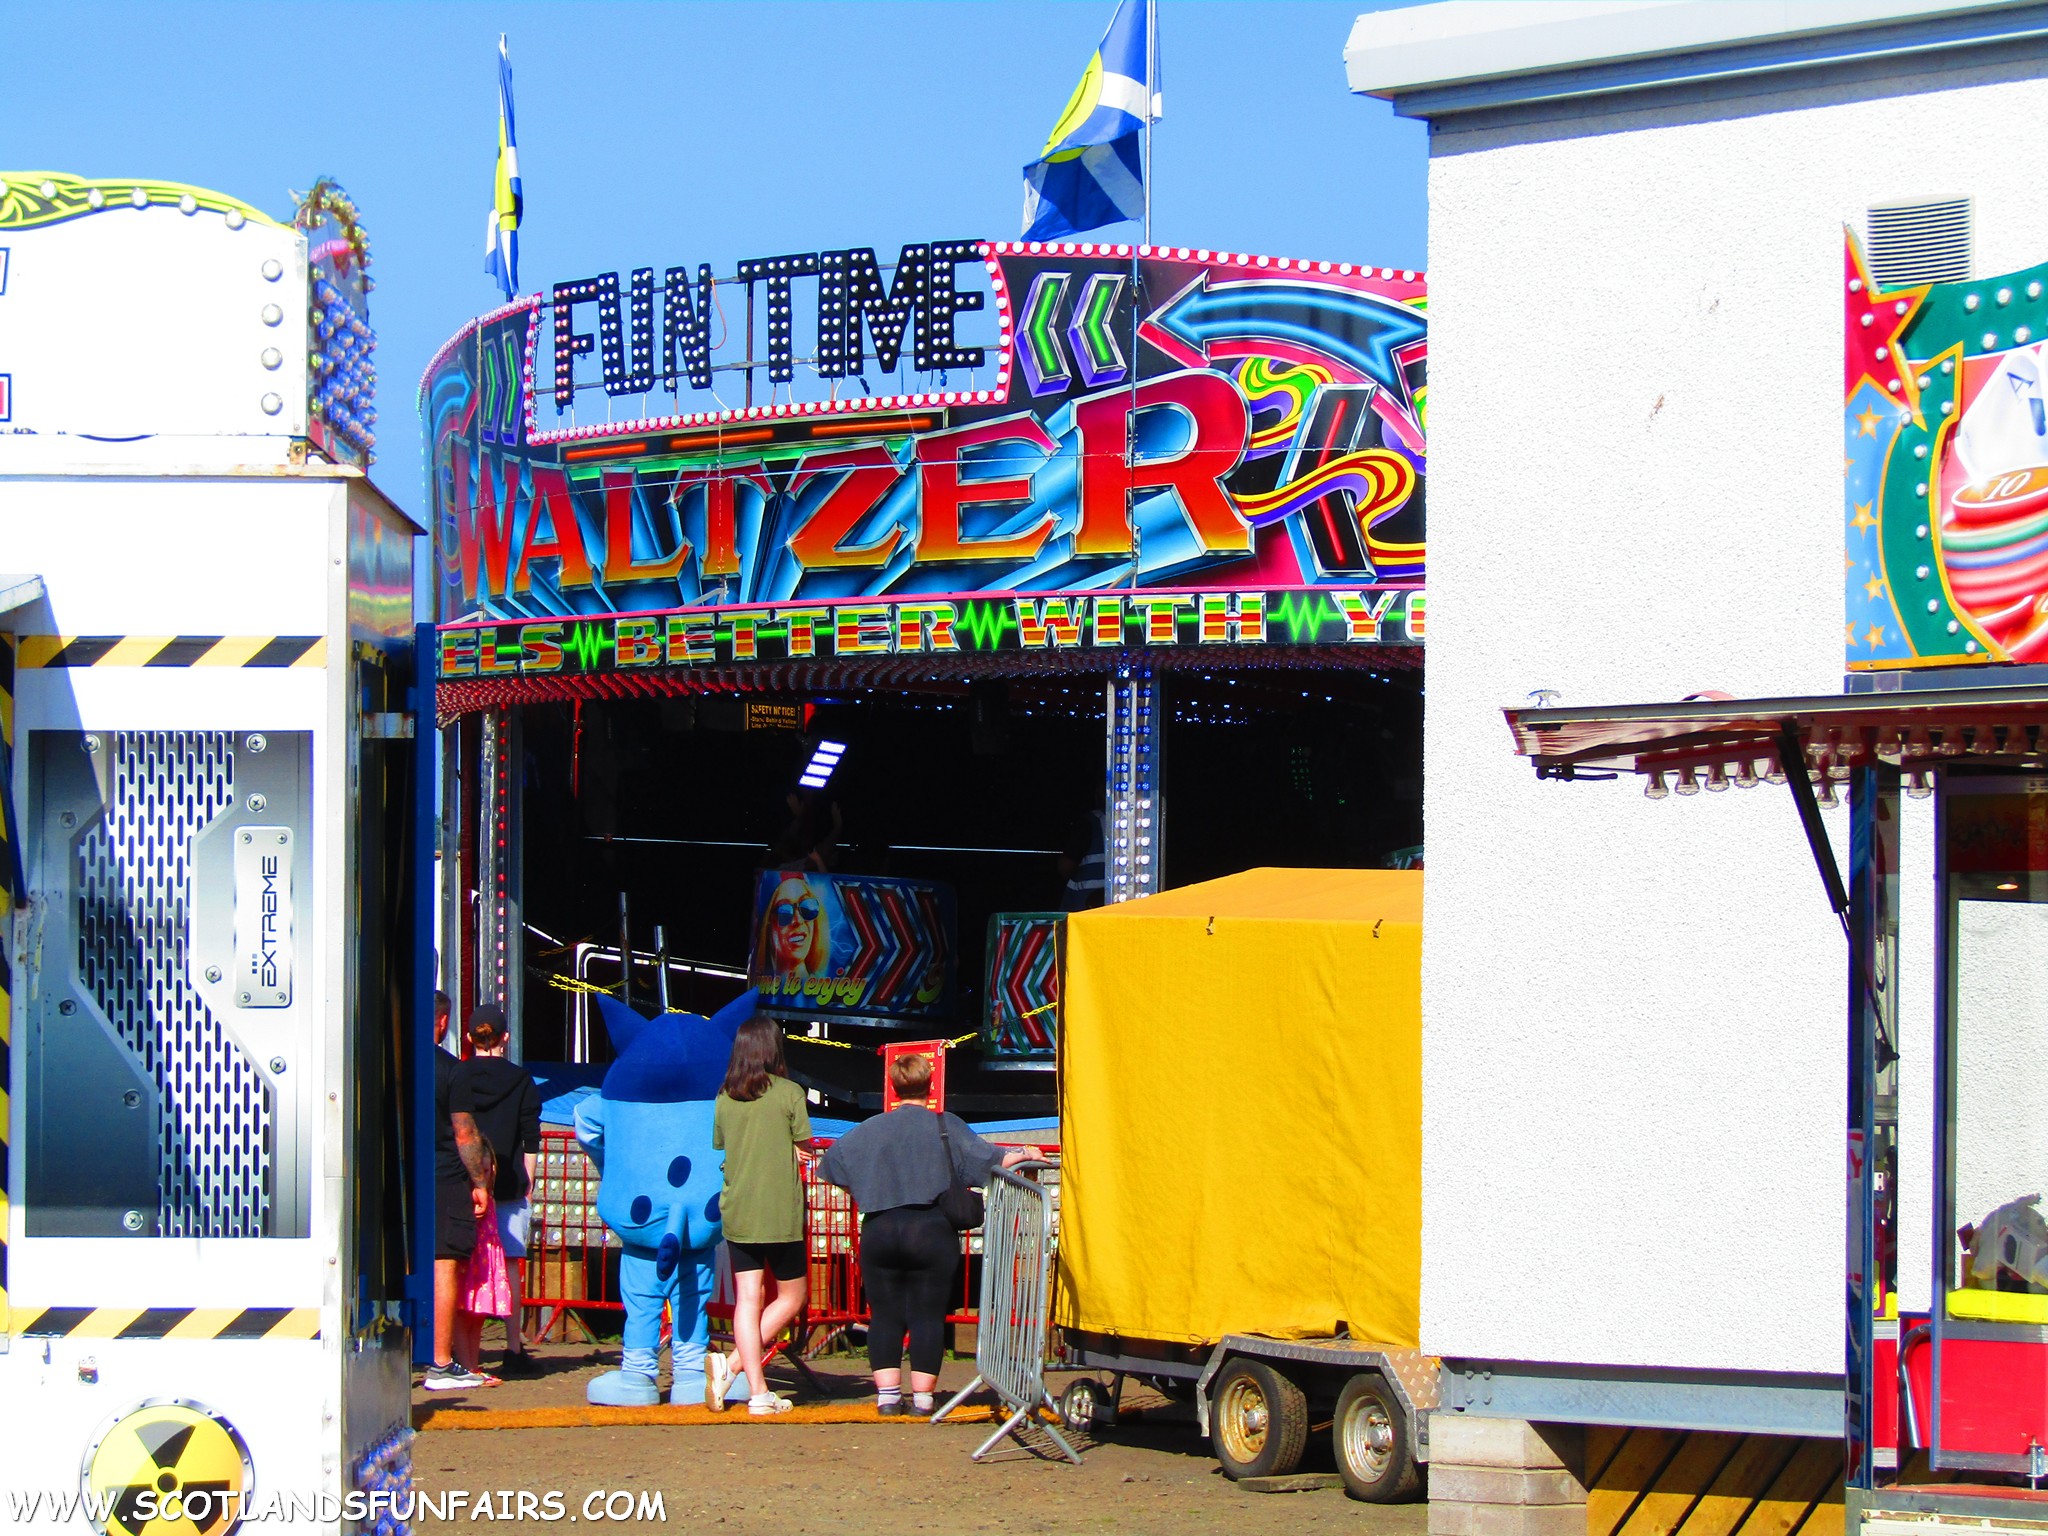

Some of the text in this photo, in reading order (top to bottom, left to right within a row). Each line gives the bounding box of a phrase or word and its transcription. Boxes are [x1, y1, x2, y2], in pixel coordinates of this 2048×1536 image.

[553, 239, 986, 408] FUN TIME
[449, 368, 1255, 604] WALTZER
[1981, 472, 2032, 502] 10
[438, 622, 565, 678] ELS
[614, 601, 962, 669] BETTER
[1012, 592, 1267, 648] WITH
[751, 705, 773, 715] SAFETY
[262, 855, 278, 987] EXTREME
[783, 971, 802, 996] to
[803, 967, 868, 1006] enjoy
